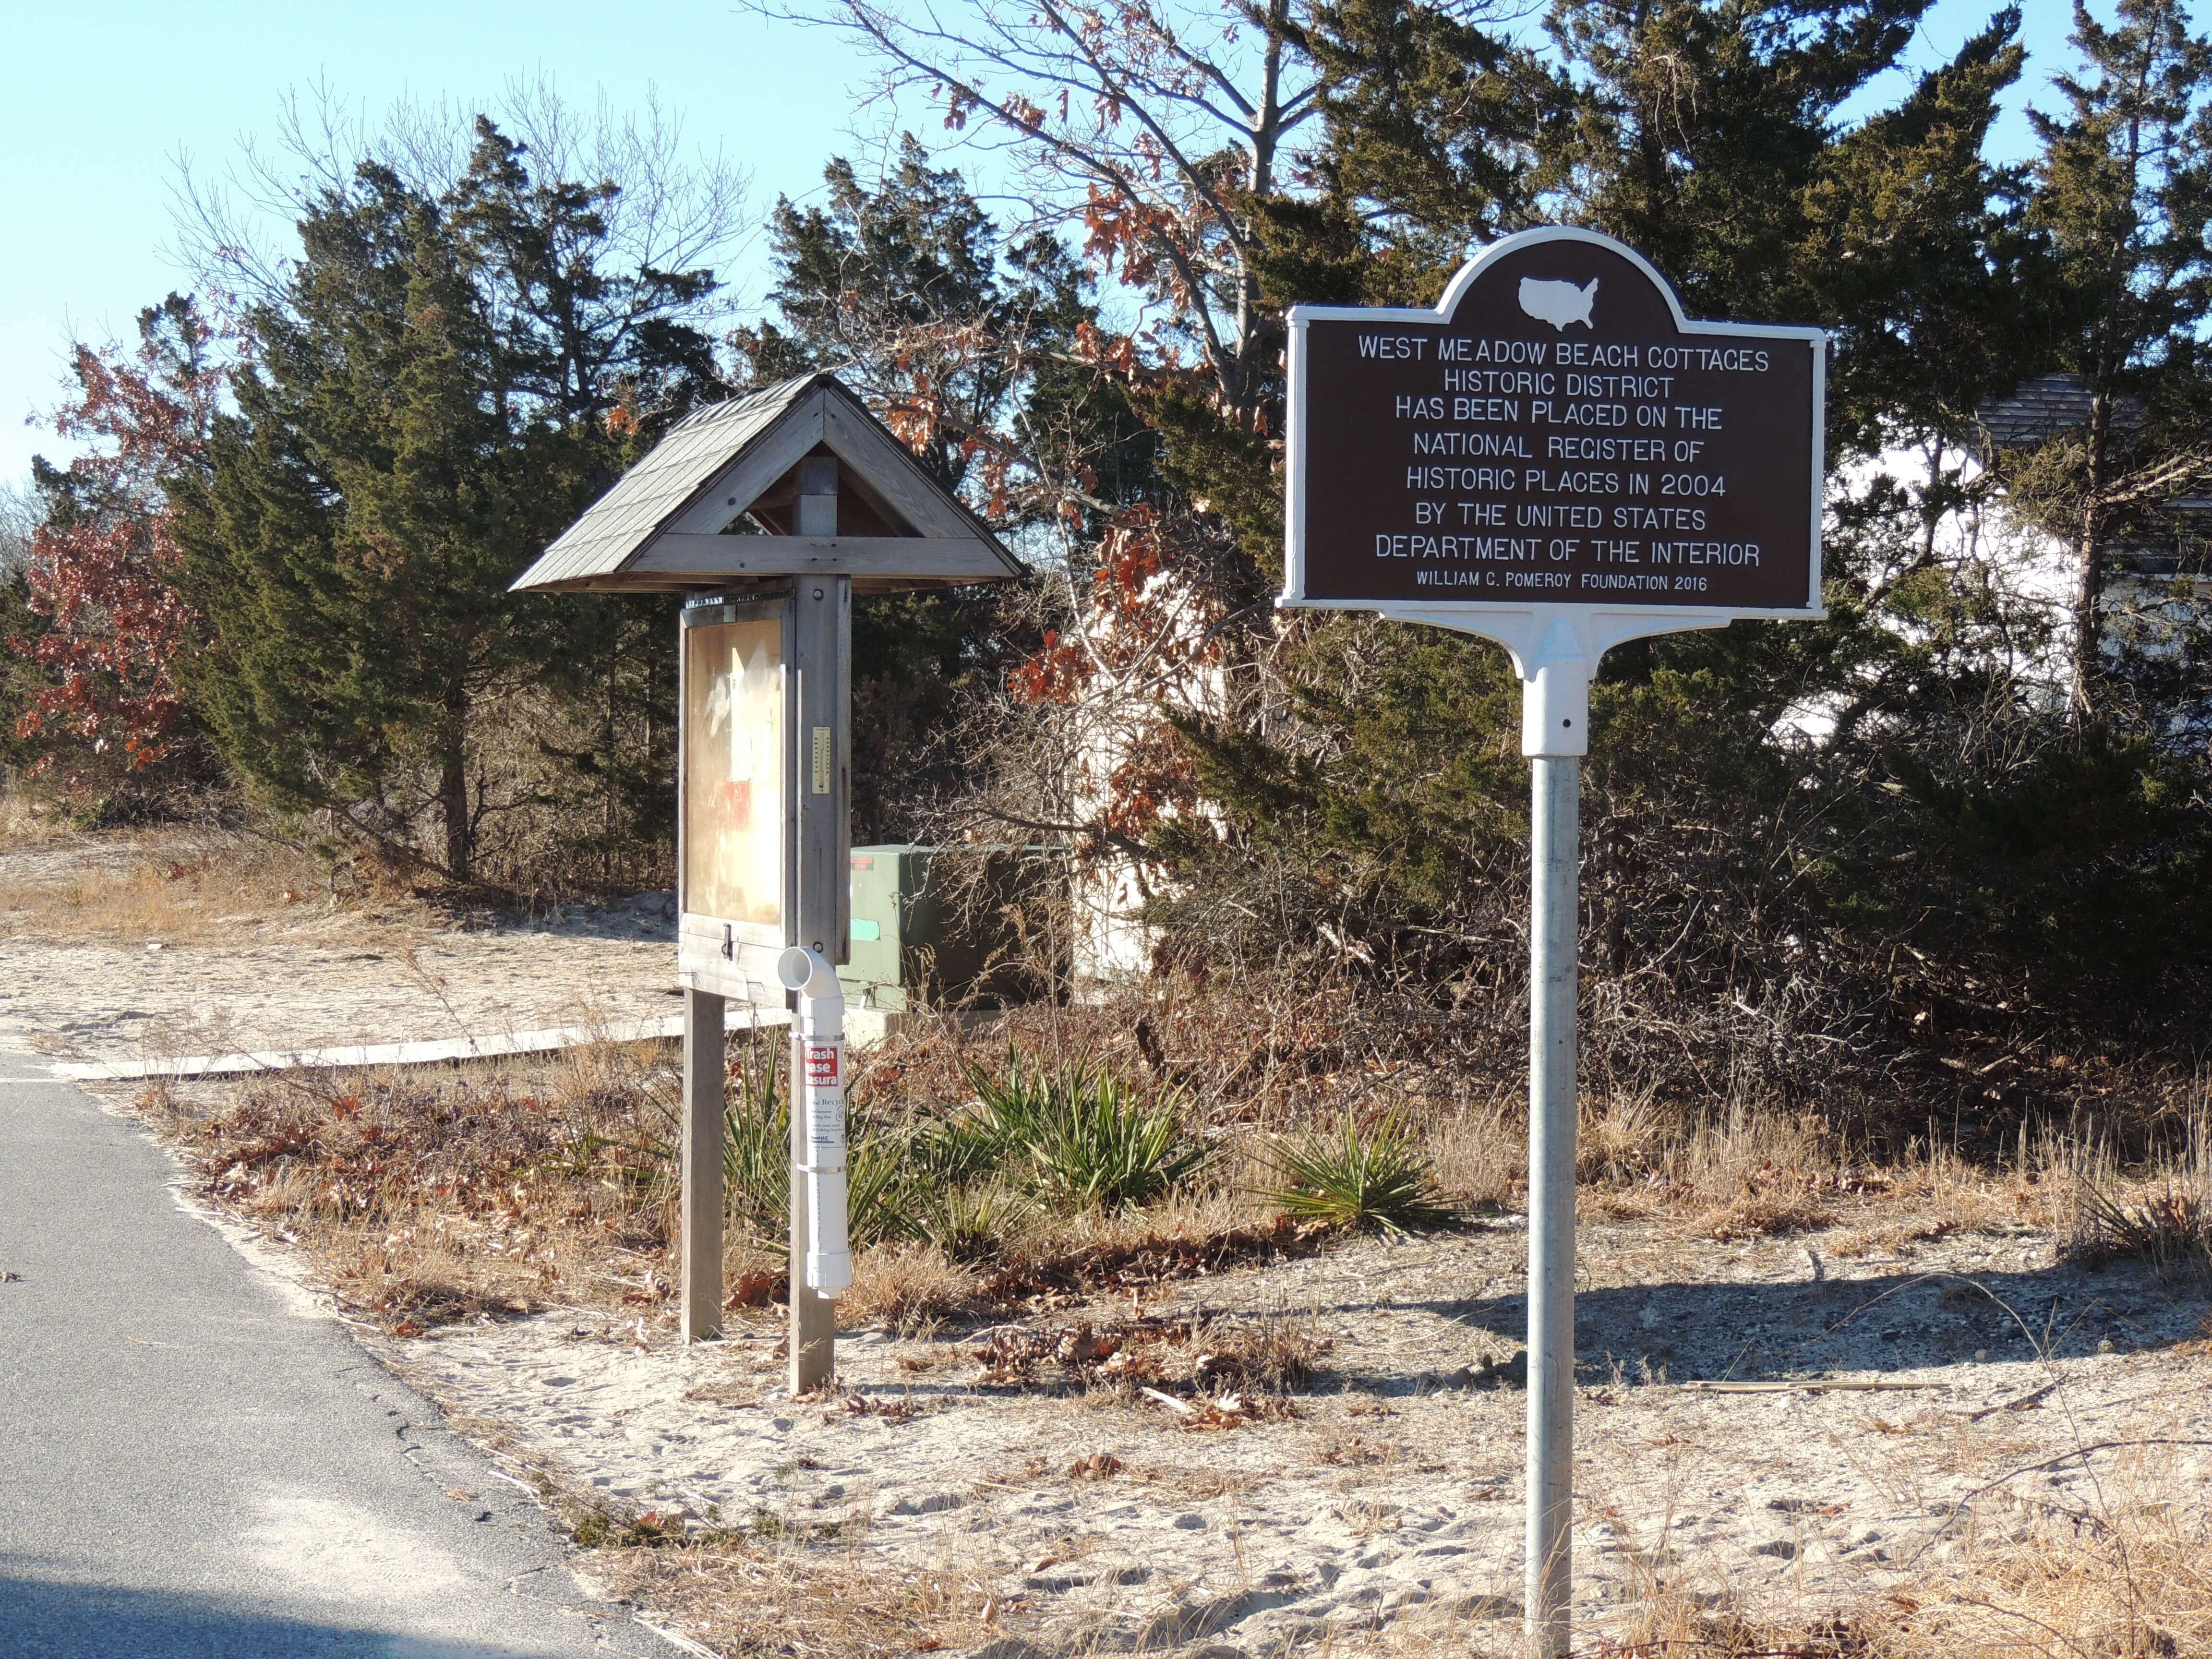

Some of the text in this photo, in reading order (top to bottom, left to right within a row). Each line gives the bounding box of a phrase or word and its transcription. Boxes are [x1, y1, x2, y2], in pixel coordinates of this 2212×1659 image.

[1358, 335, 1768, 372] WEST MEADOW BEACH COTTAGES
[1445, 369, 1674, 398] HISTORIC DISTRICT
[1396, 396, 1722, 430] HAS BEEN PLACED ON THE
[1414, 433, 1704, 462] NATIONAL REGISTER OF
[1407, 466, 1726, 496] HISTORIC PLACES IN 2004
[1416, 502, 1705, 530] BY THE UNITED STATES
[1376, 534, 1759, 566] DEPARTMENT OF THE INTERIOR
[1417, 570, 1707, 591] WILLIAM G. POMEROY FOUNDATION 2016
